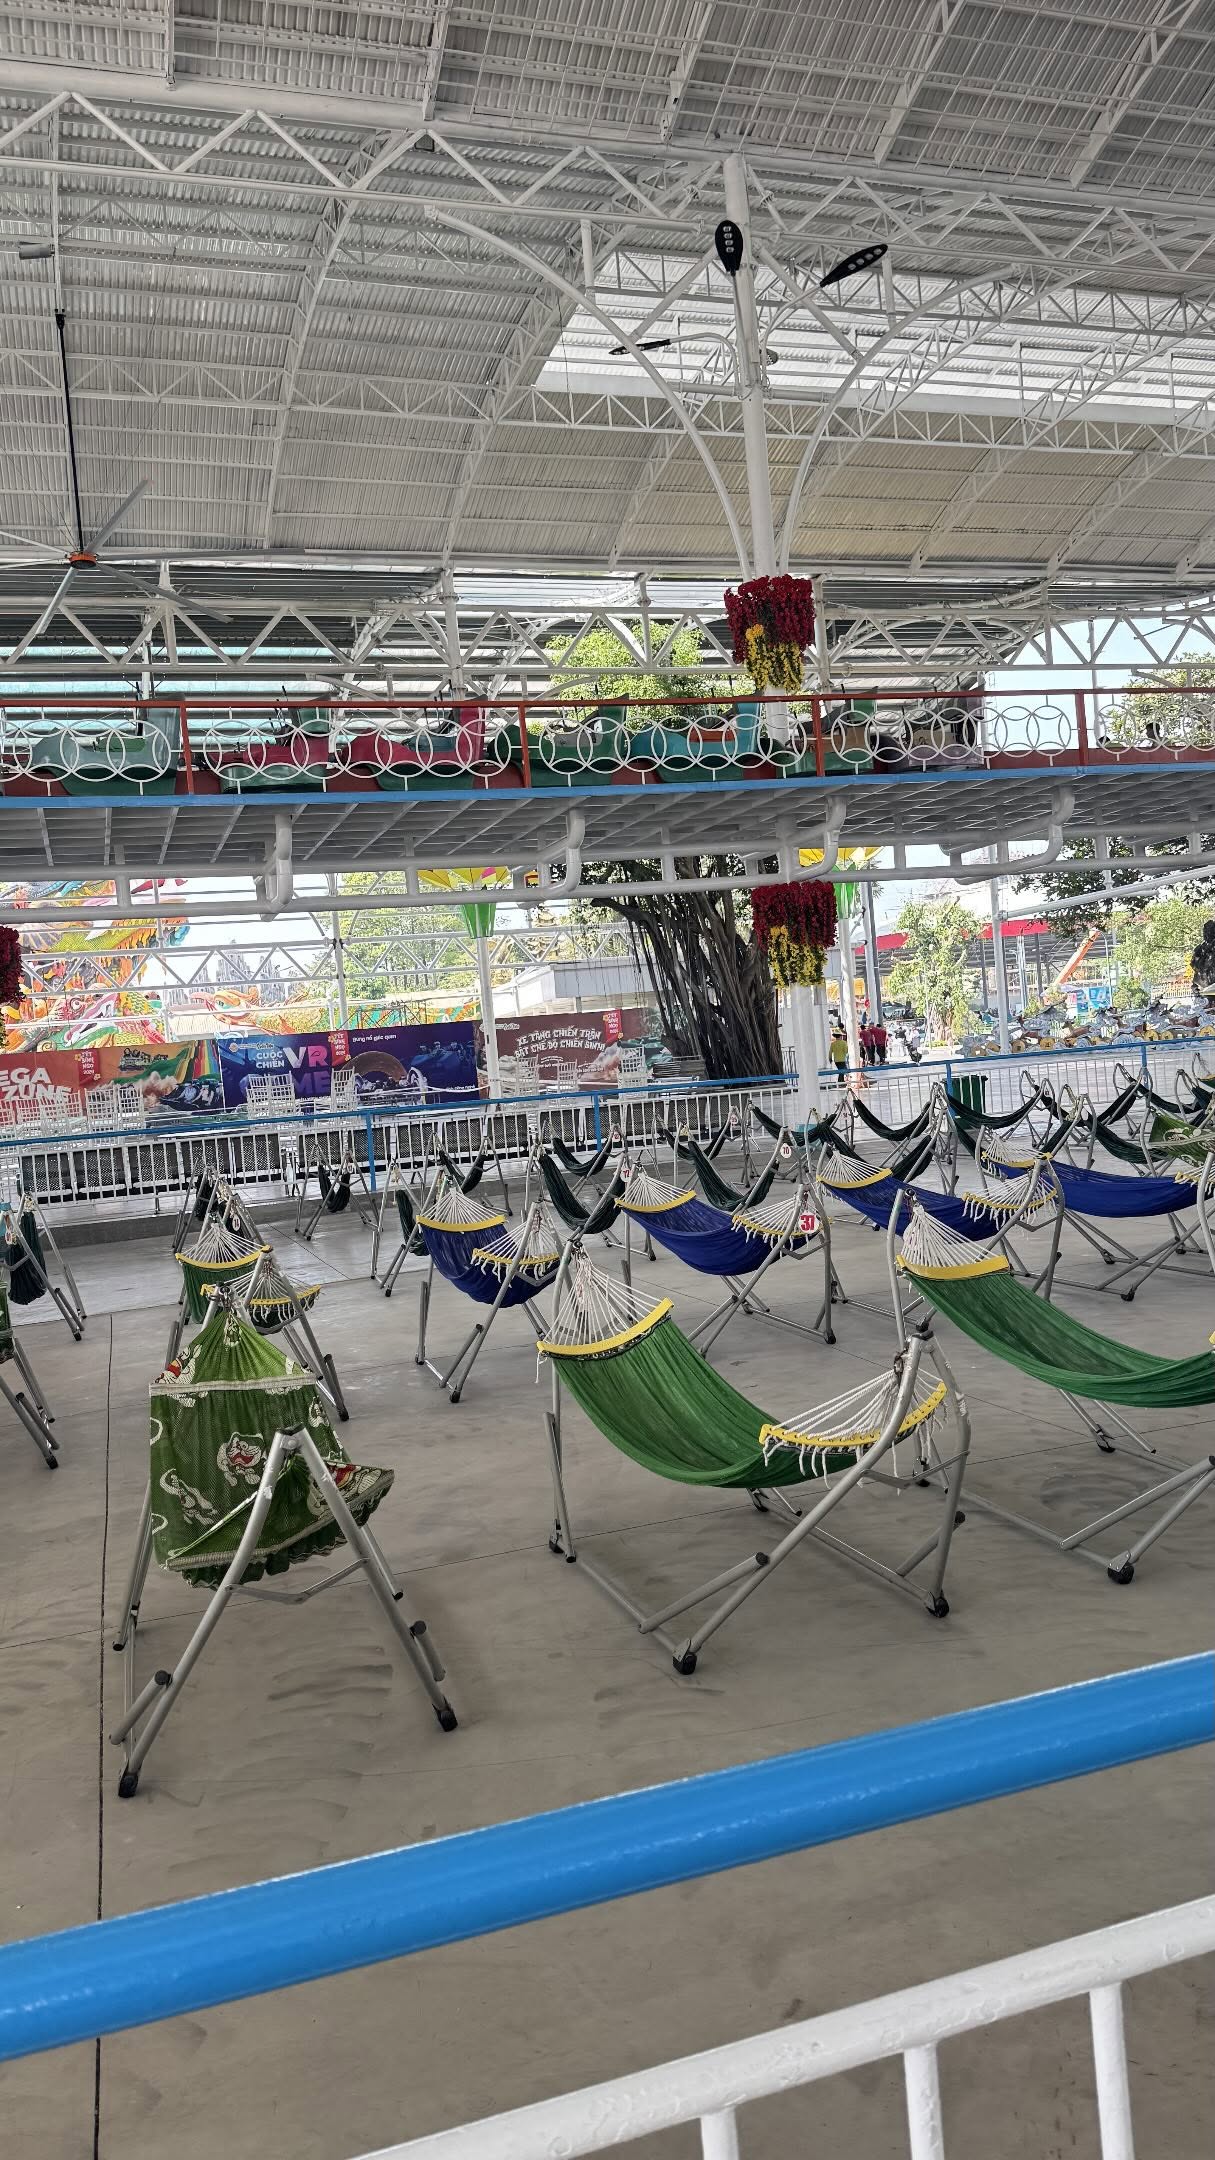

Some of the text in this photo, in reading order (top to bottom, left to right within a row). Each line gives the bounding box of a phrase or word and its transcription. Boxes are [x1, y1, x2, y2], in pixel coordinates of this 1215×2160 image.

[516, 1035, 528, 1046] XE
[553, 1025, 579, 1037] CHIẾN
[256, 1049, 283, 1060] CUỘC
[256, 1058, 285, 1068] CHIẾN
[283, 1045, 329, 1068] VR
[0, 1067, 52, 1087] EGA
[800, 1215, 815, 1231] 37
